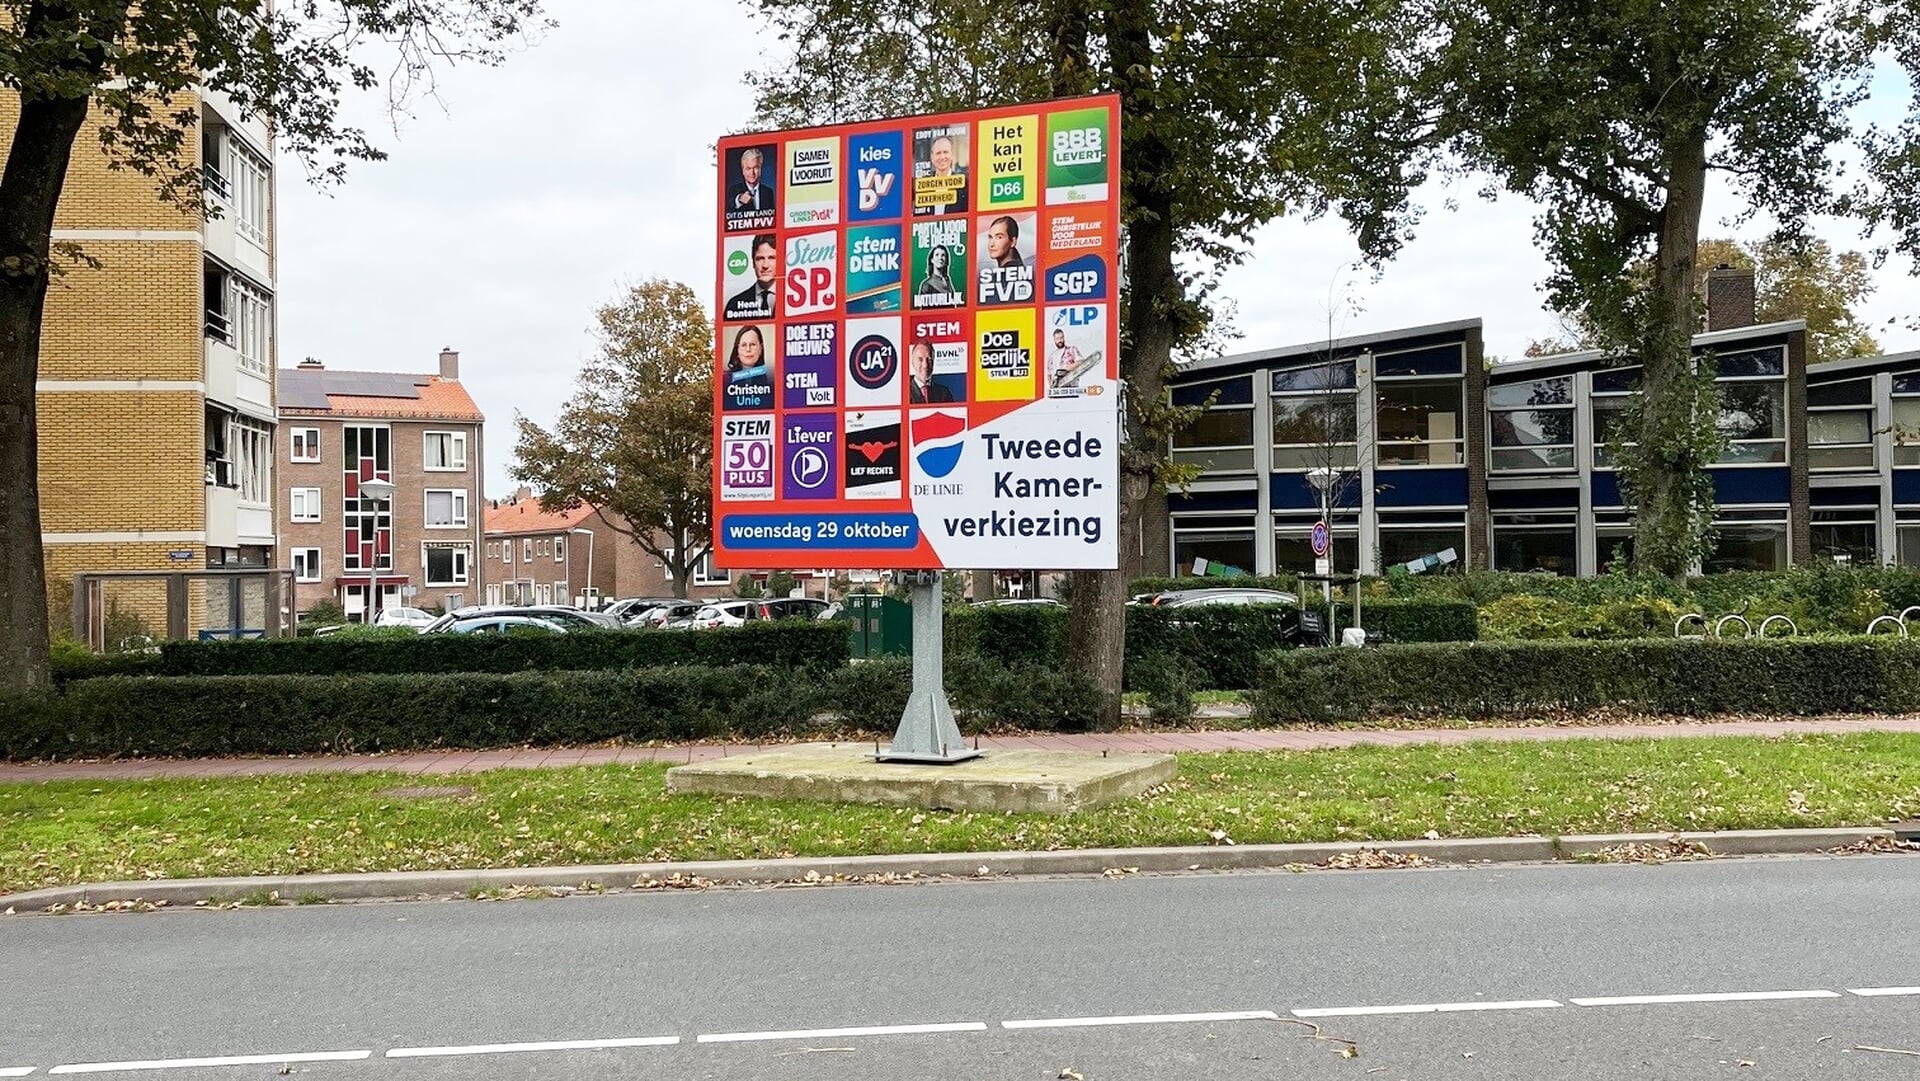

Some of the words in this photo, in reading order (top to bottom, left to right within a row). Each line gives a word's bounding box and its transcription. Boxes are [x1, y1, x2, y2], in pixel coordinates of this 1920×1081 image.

[994, 125, 1023, 140] Het
[1053, 128, 1102, 149] BBB
[798, 150, 829, 162] SAMEN
[860, 146, 891, 162] kies
[993, 143, 1022, 156] kan
[993, 158, 1022, 173] wél
[795, 168, 832, 180] VOORUIT
[917, 180, 943, 189] ZORGEN
[945, 177, 963, 186] VOOR
[993, 182, 1021, 196] D66
[728, 219, 751, 230] STEM
[754, 217, 774, 228] PVV
[943, 219, 967, 233] VOOR
[1052, 216, 1075, 225] STEM
[1052, 222, 1101, 232] CHRISTELIJK
[1052, 231, 1074, 240] VOOR
[1052, 238, 1101, 248] NEDERLAND
[786, 238, 836, 267] Stem
[853, 236, 896, 254] stem
[728, 259, 747, 267] CDA
[849, 252, 900, 273] DENK
[980, 266, 1033, 283] STEM
[1053, 271, 1098, 295] SGP
[979, 281, 1033, 303] FVD
[726, 308, 772, 319] Bontenbal
[1069, 307, 1099, 326] LP
[786, 325, 808, 341] DOE
[809, 323, 835, 340] IETS
[916, 321, 960, 337] STEM
[982, 332, 1013, 347] Doe
[786, 340, 831, 356] NIEUWS
[936, 349, 960, 358] BVNL
[860, 346, 892, 370] JA21
[981, 349, 1030, 368] eerlijk.
[786, 373, 818, 389] STEM
[727, 384, 771, 395] Christen
[810, 391, 831, 401] Volt
[736, 396, 761, 406] Unie
[725, 420, 771, 436] STEM
[788, 426, 833, 443] Liever
[981, 431, 1102, 460] Tweede
[729, 442, 766, 469] 50
[730, 471, 765, 484] PLUS
[850, 467, 866, 476] LIEF
[914, 485, 929, 496] DE
[932, 484, 963, 496] LINIE
[994, 471, 1102, 498] Kamer-
[730, 522, 811, 542] woensdag
[817, 522, 838, 538] 29
[843, 522, 909, 538] oktober
[943, 509, 1101, 544] verkiezing
